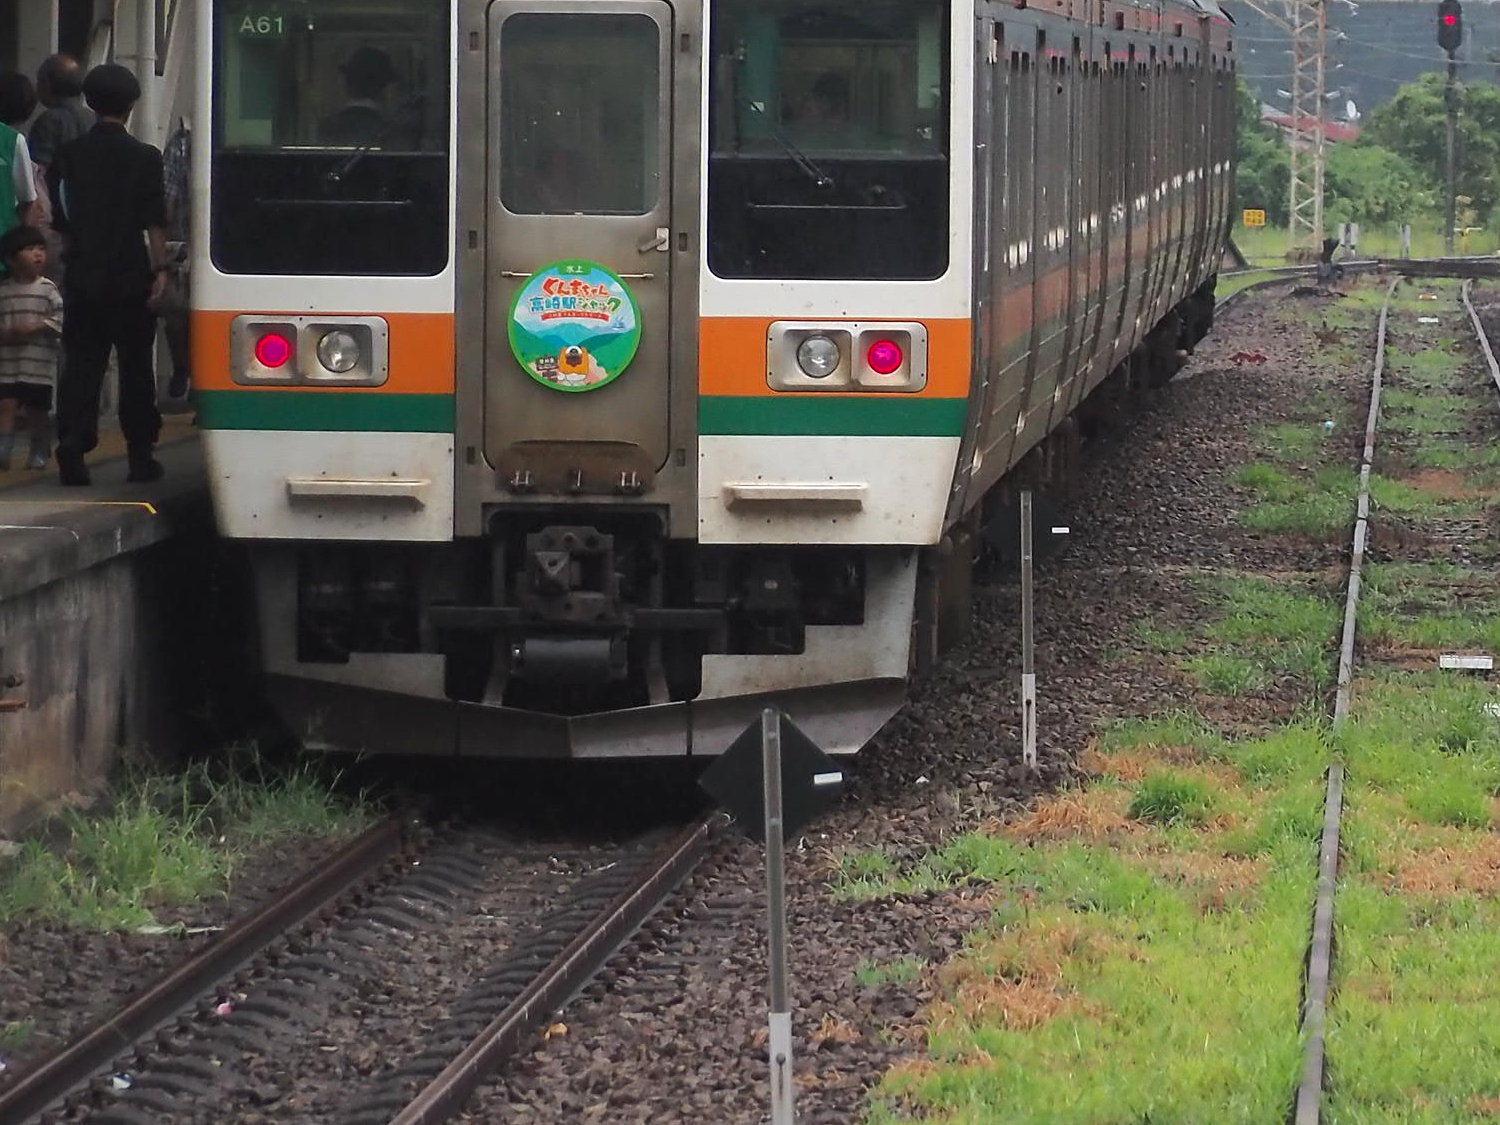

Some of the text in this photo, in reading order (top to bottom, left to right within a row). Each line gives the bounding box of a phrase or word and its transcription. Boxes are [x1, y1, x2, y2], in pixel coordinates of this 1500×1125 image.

[238, 15, 283, 34] A61
[529, 295, 622, 314] 高崎駅ジャック
